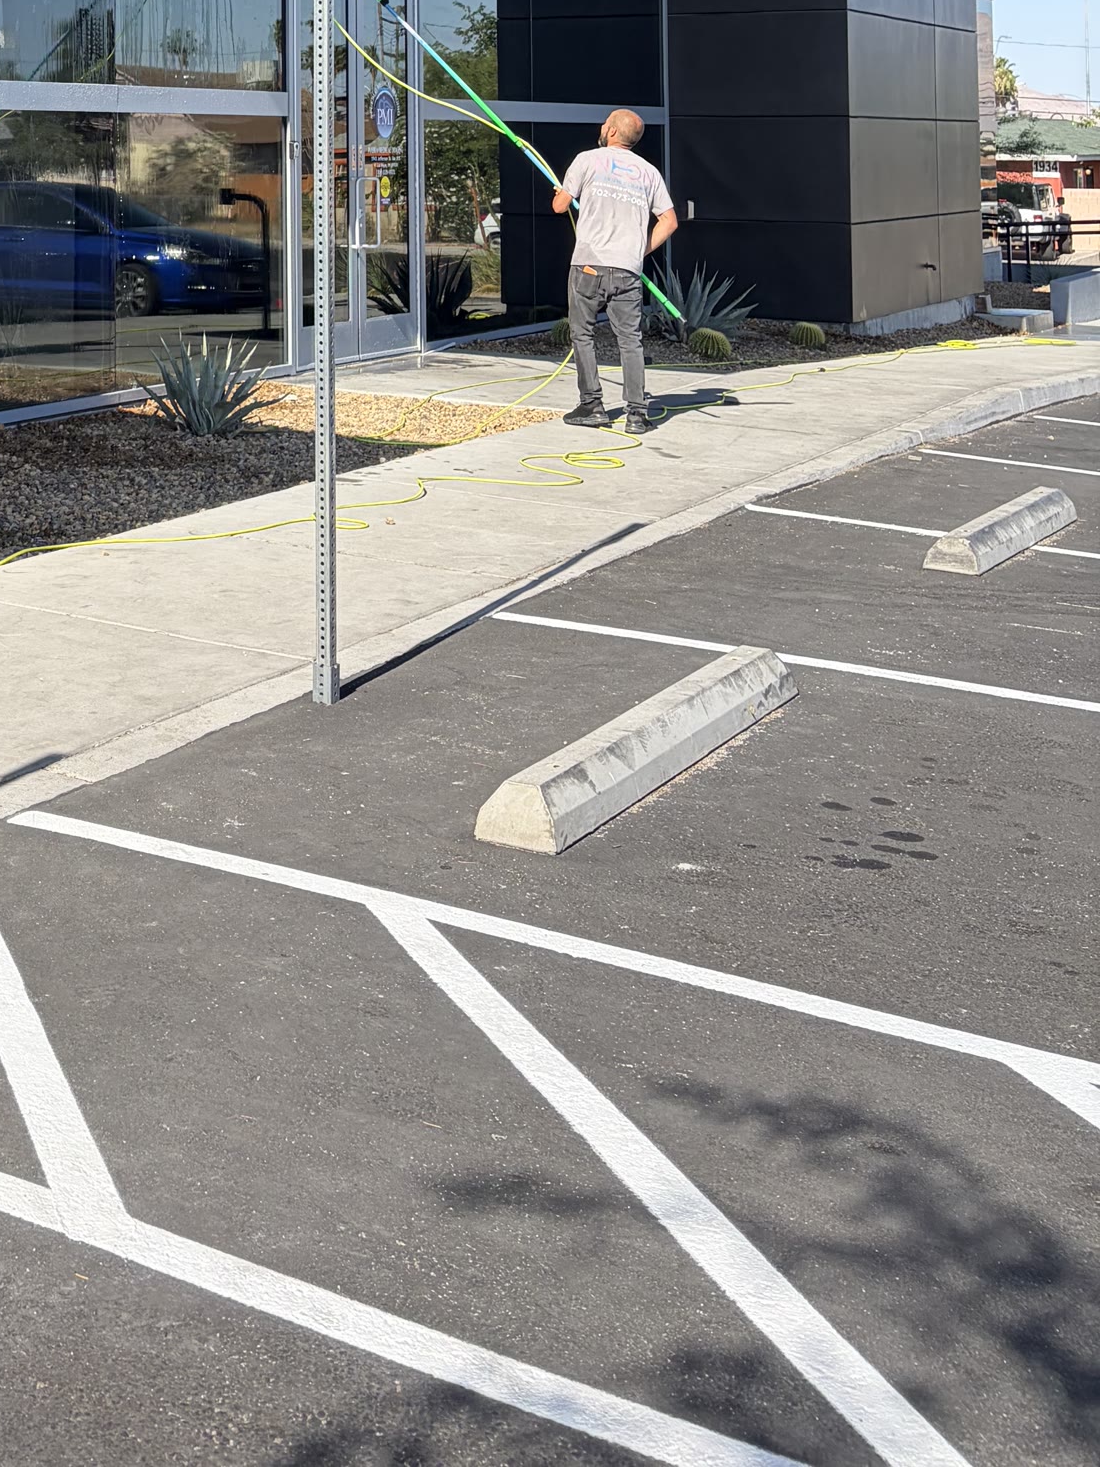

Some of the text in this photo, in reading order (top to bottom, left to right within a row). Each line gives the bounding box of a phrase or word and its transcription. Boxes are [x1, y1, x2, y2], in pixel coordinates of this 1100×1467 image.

[377, 108, 393, 126] PMI
[595, 156, 655, 188] NEON
[1033, 160, 1058, 172] 1934
